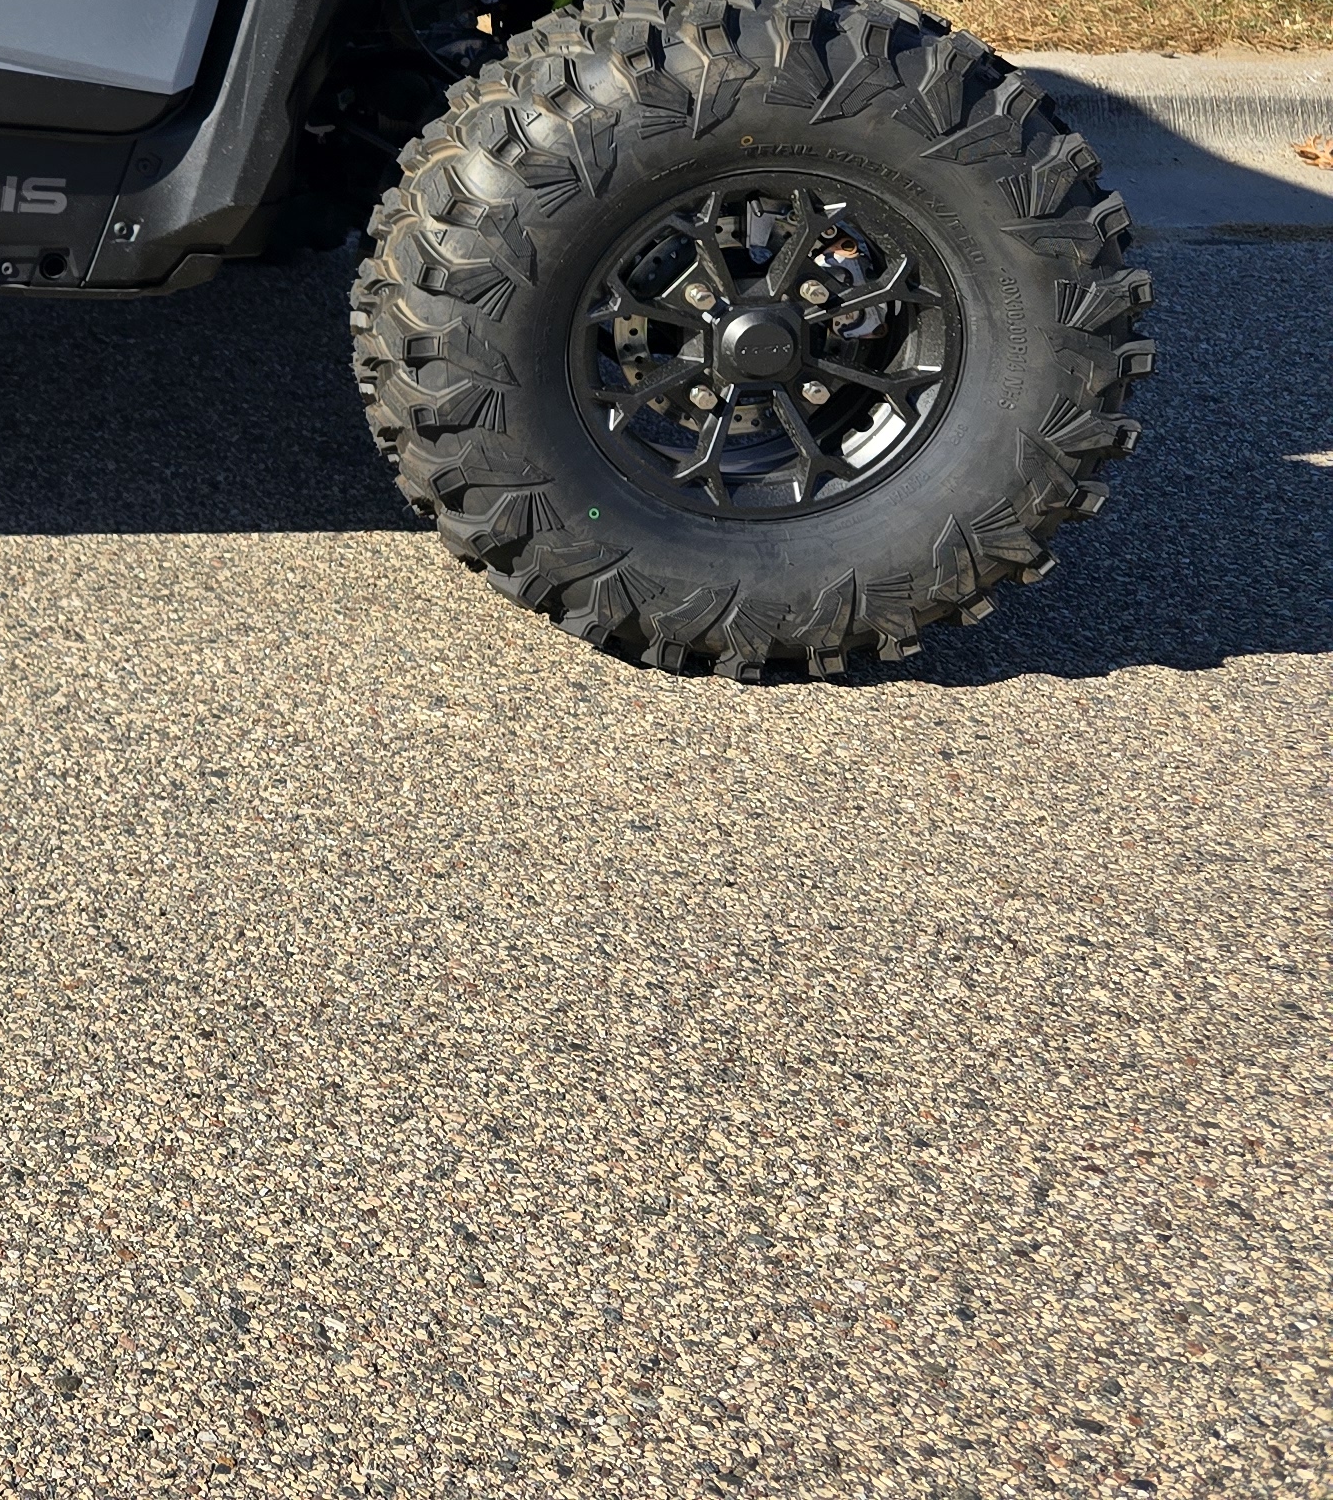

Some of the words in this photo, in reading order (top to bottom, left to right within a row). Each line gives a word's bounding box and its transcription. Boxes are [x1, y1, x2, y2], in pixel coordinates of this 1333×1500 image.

[742, 144, 819, 159] TRAIL
[824, 148, 927, 197] MASTER
[998, 274, 1028, 374] 30X10.00R14
